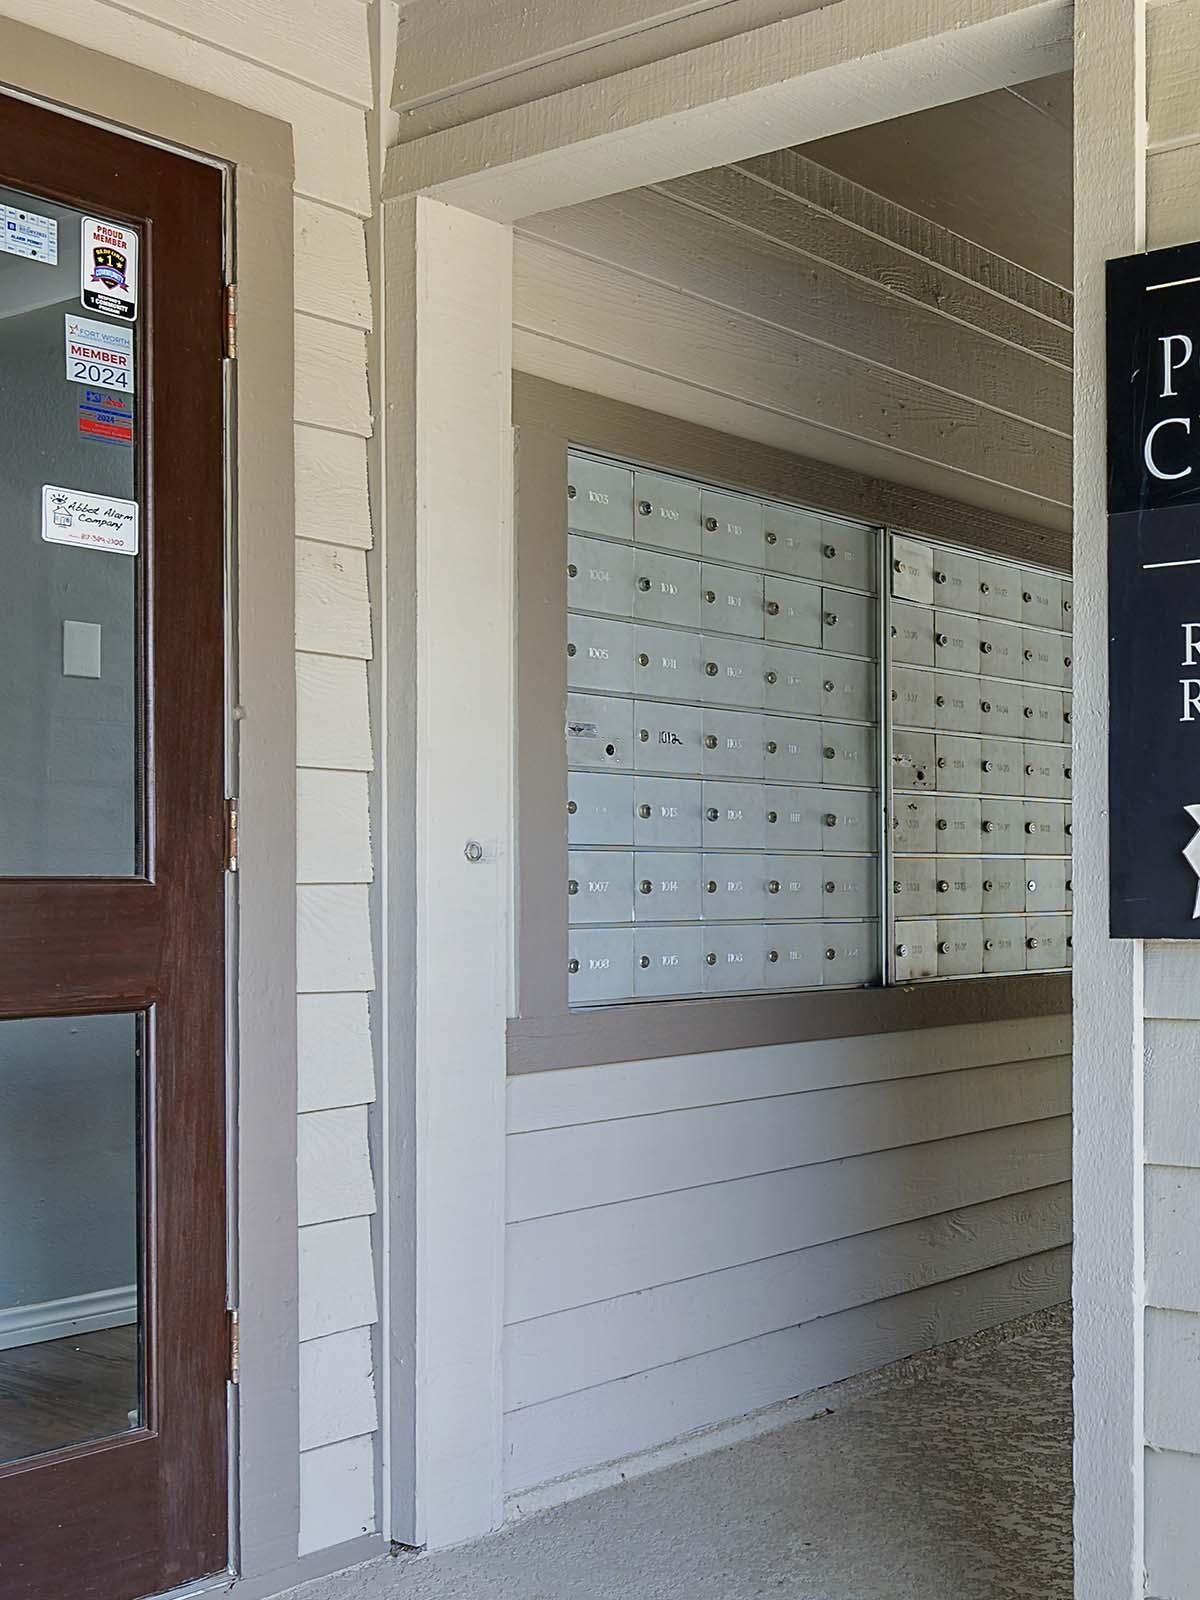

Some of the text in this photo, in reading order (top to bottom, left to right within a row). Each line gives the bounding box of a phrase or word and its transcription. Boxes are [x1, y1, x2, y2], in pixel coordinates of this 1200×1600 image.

[96, 225, 124, 240] PROUD
[93, 233, 127, 249] MEMBER
[95, 248, 125, 262] BEDFORD
[106, 255, 114, 267] 1
[79, 328, 101, 339] FORT
[102, 333, 130, 346] WORTH
[71, 345, 127, 366] MEMBER
[74, 362, 128, 388] 2024
[96, 414, 116, 424] 2024
[588, 490, 609, 505] 1003
[78, 513, 123, 531] Company
[104, 508, 133, 521] Alarm
[658, 731, 683, 745] 1012
[588, 880, 609, 893] 1007
